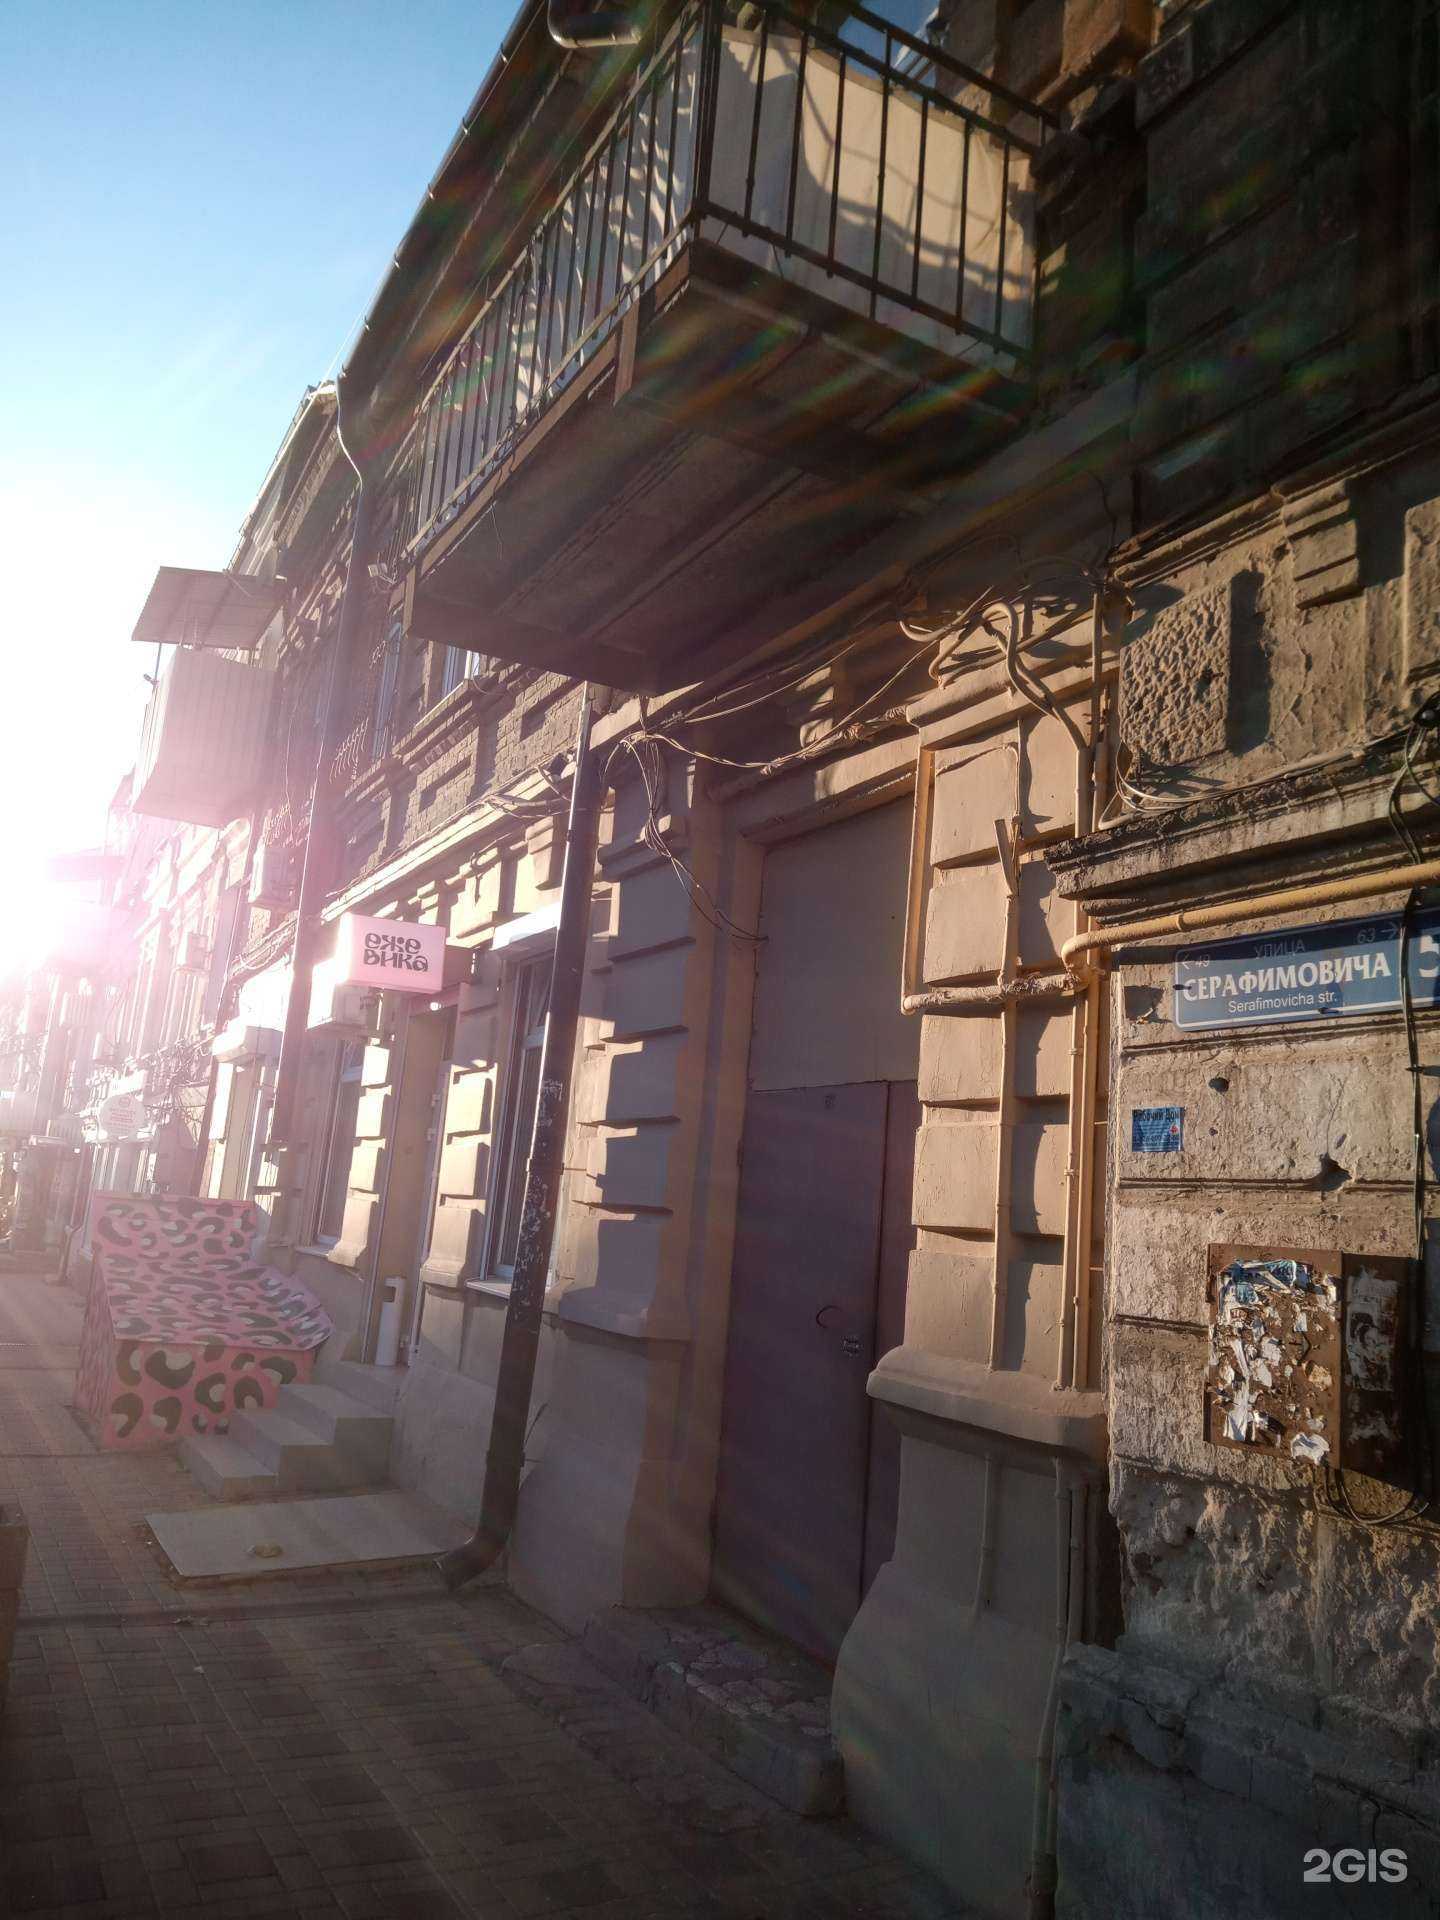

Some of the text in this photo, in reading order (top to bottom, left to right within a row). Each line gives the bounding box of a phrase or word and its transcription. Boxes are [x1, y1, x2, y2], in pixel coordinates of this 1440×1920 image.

[1356, 928, 1376, 944] 63
[1253, 938, 1306, 960] УЛИЦА
[1183, 952, 1392, 1002] СЕРАФИМОВИЧА
[1228, 991, 1337, 1014] Serafimovicha str.
